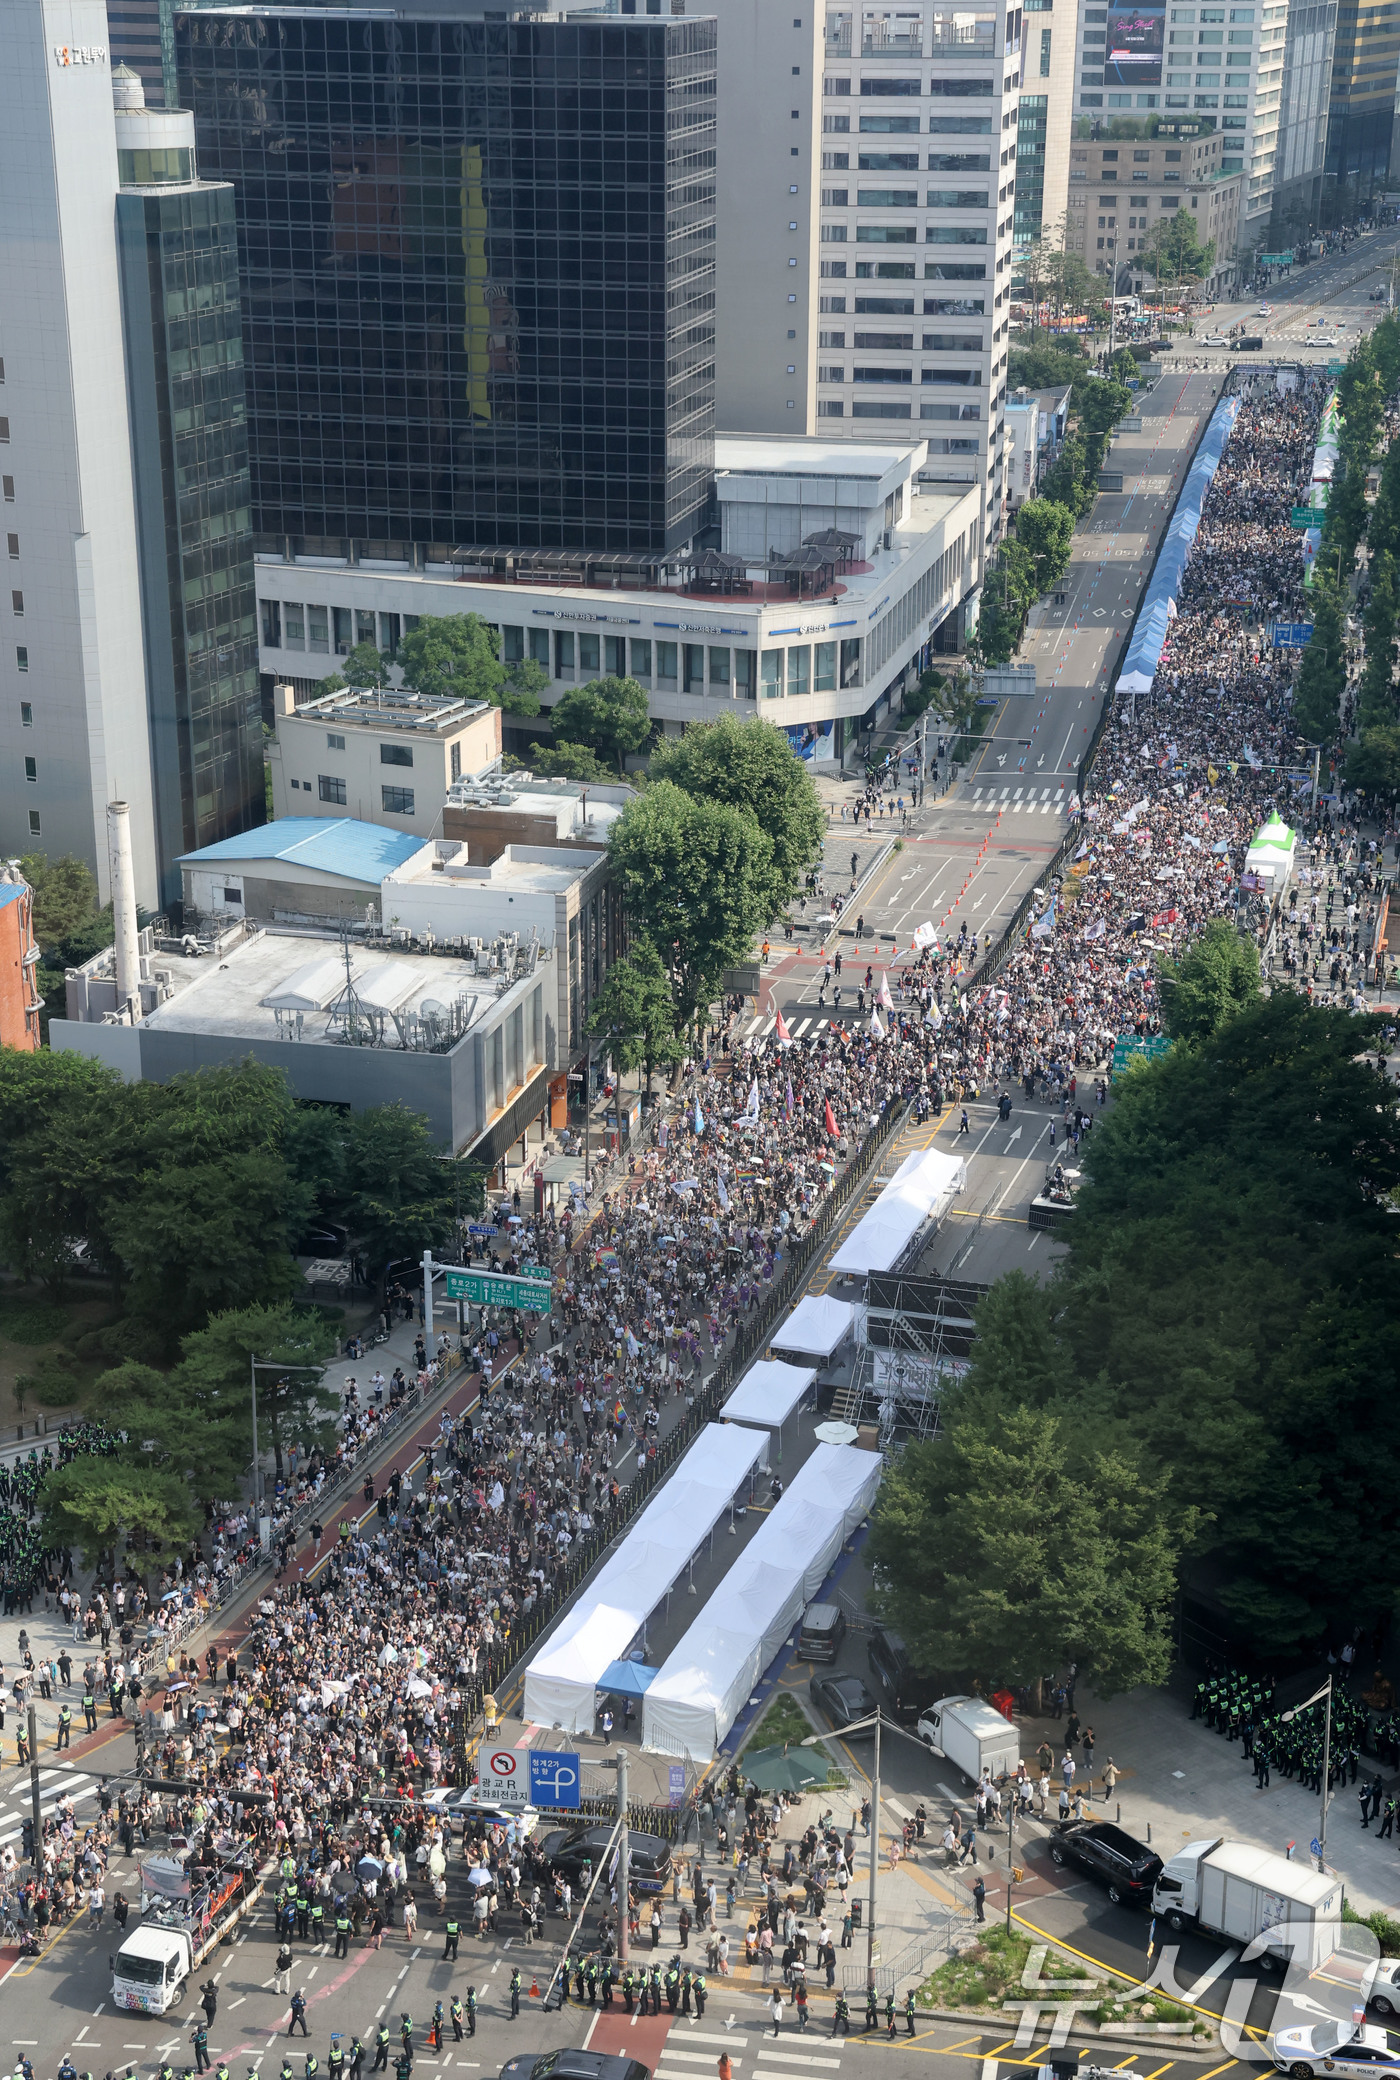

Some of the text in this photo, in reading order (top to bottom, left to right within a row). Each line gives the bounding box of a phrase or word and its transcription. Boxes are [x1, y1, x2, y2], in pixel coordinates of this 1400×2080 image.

[451, 1278, 477, 1289] 종로2가
[491, 1282, 512, 1291] 숭례문
[518, 1289, 548, 1300] 세종대로사거리
[491, 1297, 513, 1306] 을지로1가
[532, 1759, 559, 1768] 청계2가
[507, 1780, 516, 1789] R
[482, 1790, 528, 1801] 좌회전금지
[1356, 2067, 1377, 2076] POLICE
